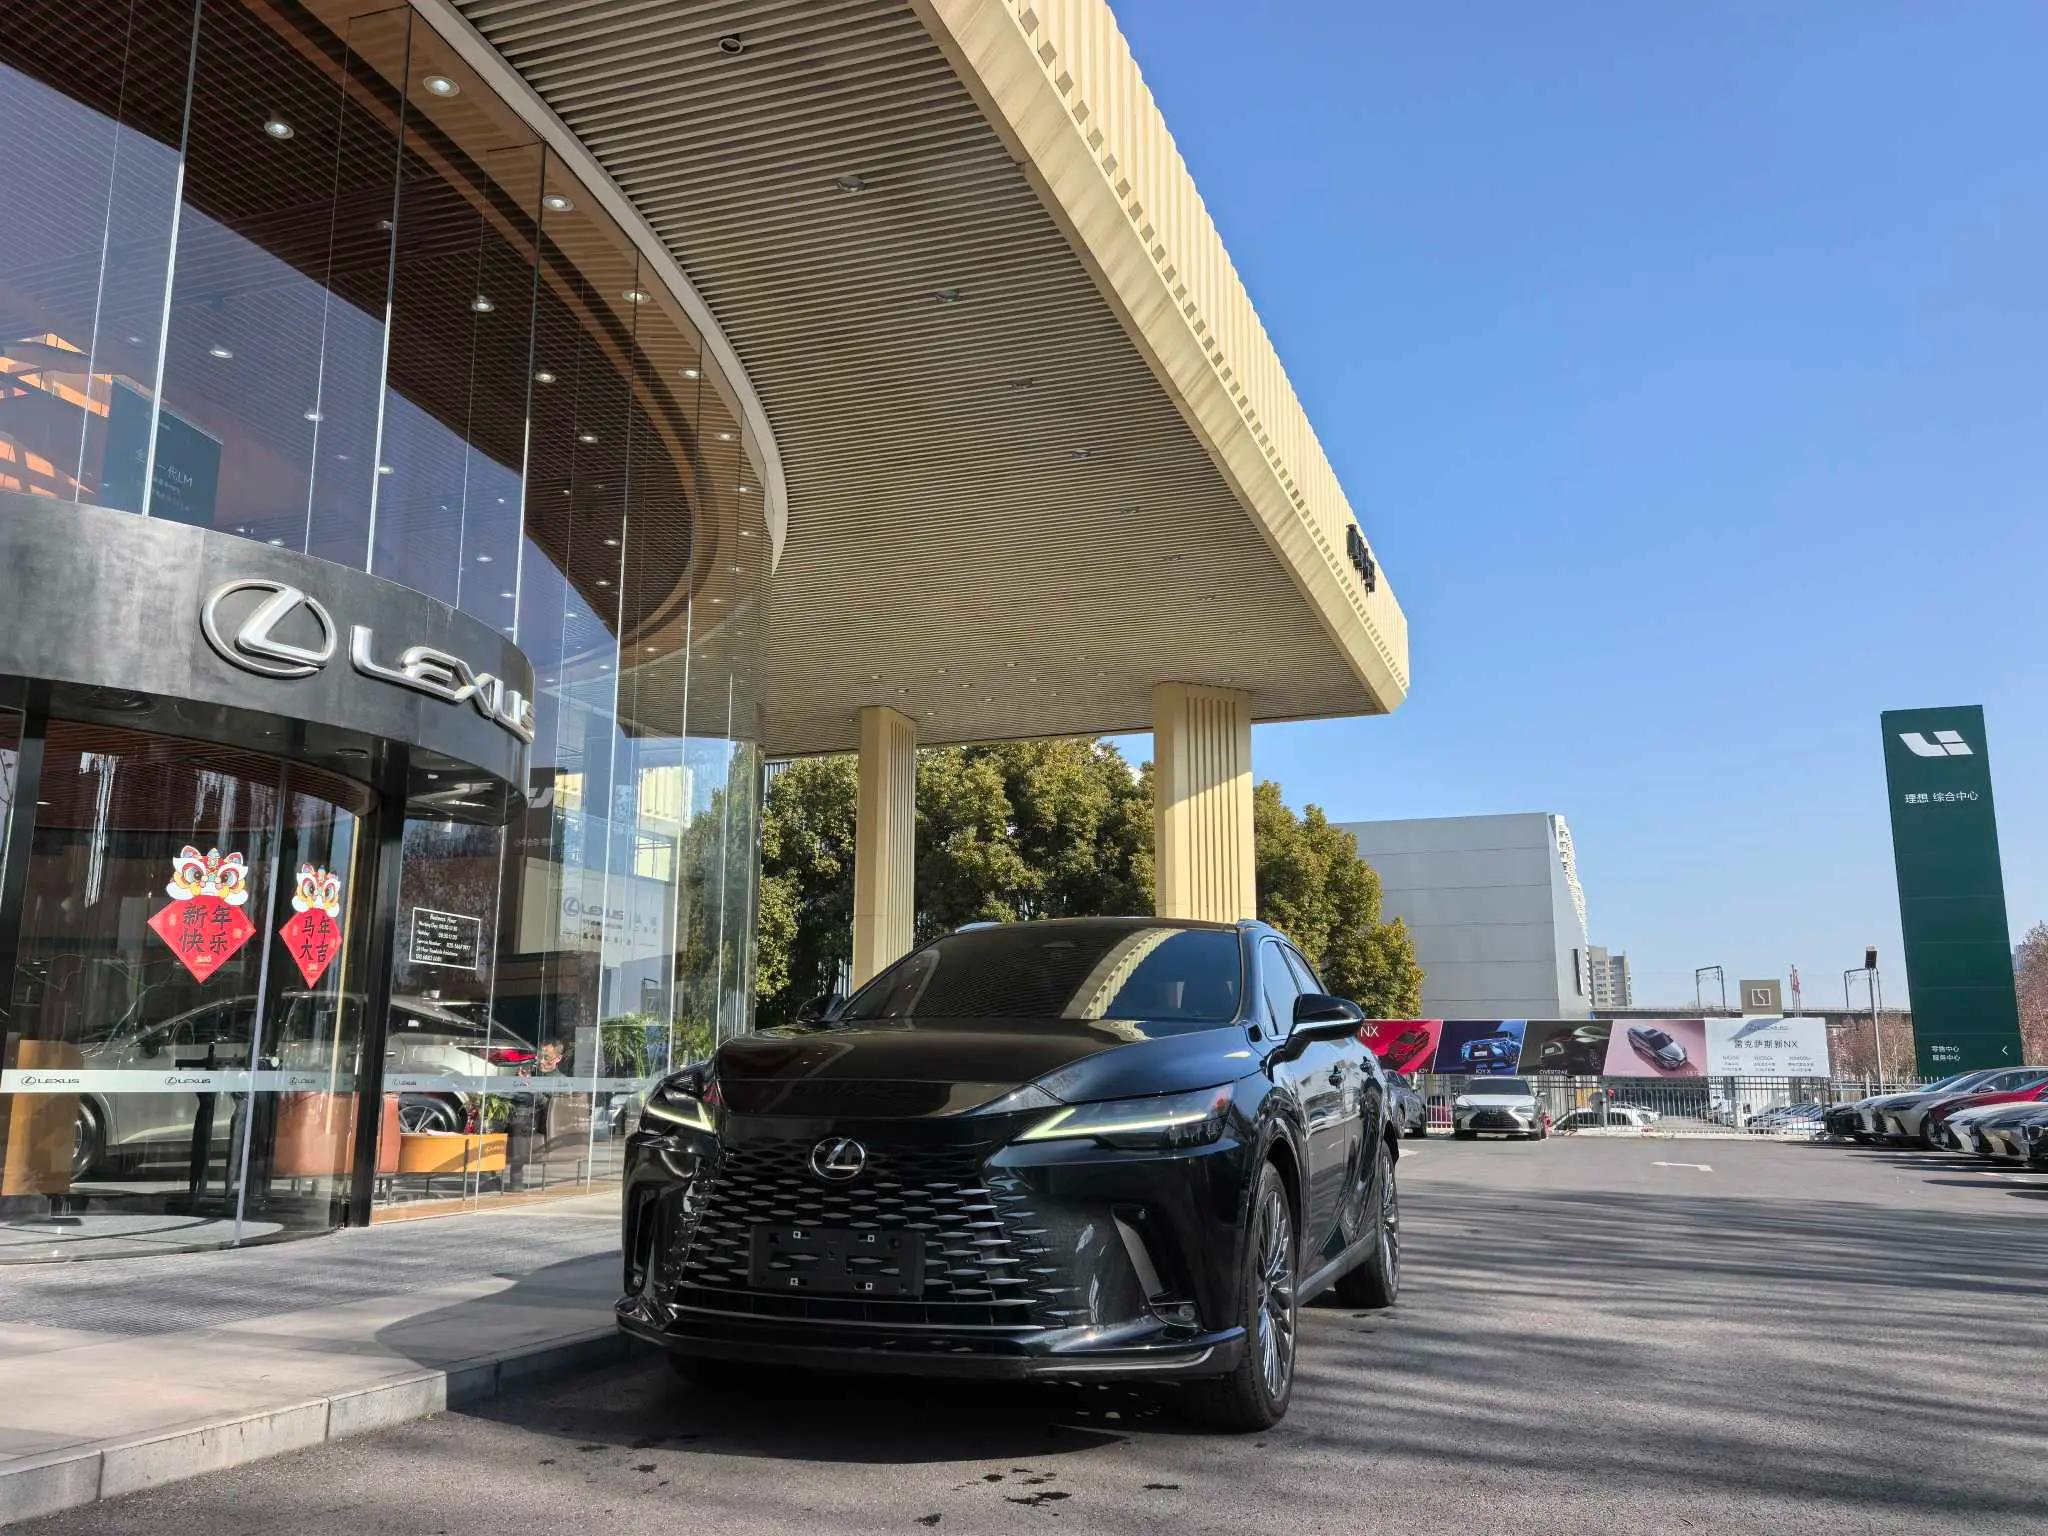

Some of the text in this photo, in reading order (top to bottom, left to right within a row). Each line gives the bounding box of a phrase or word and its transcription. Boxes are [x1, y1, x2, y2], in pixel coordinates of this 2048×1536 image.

[1904, 790, 1979, 804] 理想 综合中心
[182, 902, 233, 931] 新年
[301, 915, 331, 940] 马年
[179, 927, 229, 955] 快乐
[299, 940, 331, 963] 大吉
[1360, 1025, 1380, 1038] NX
